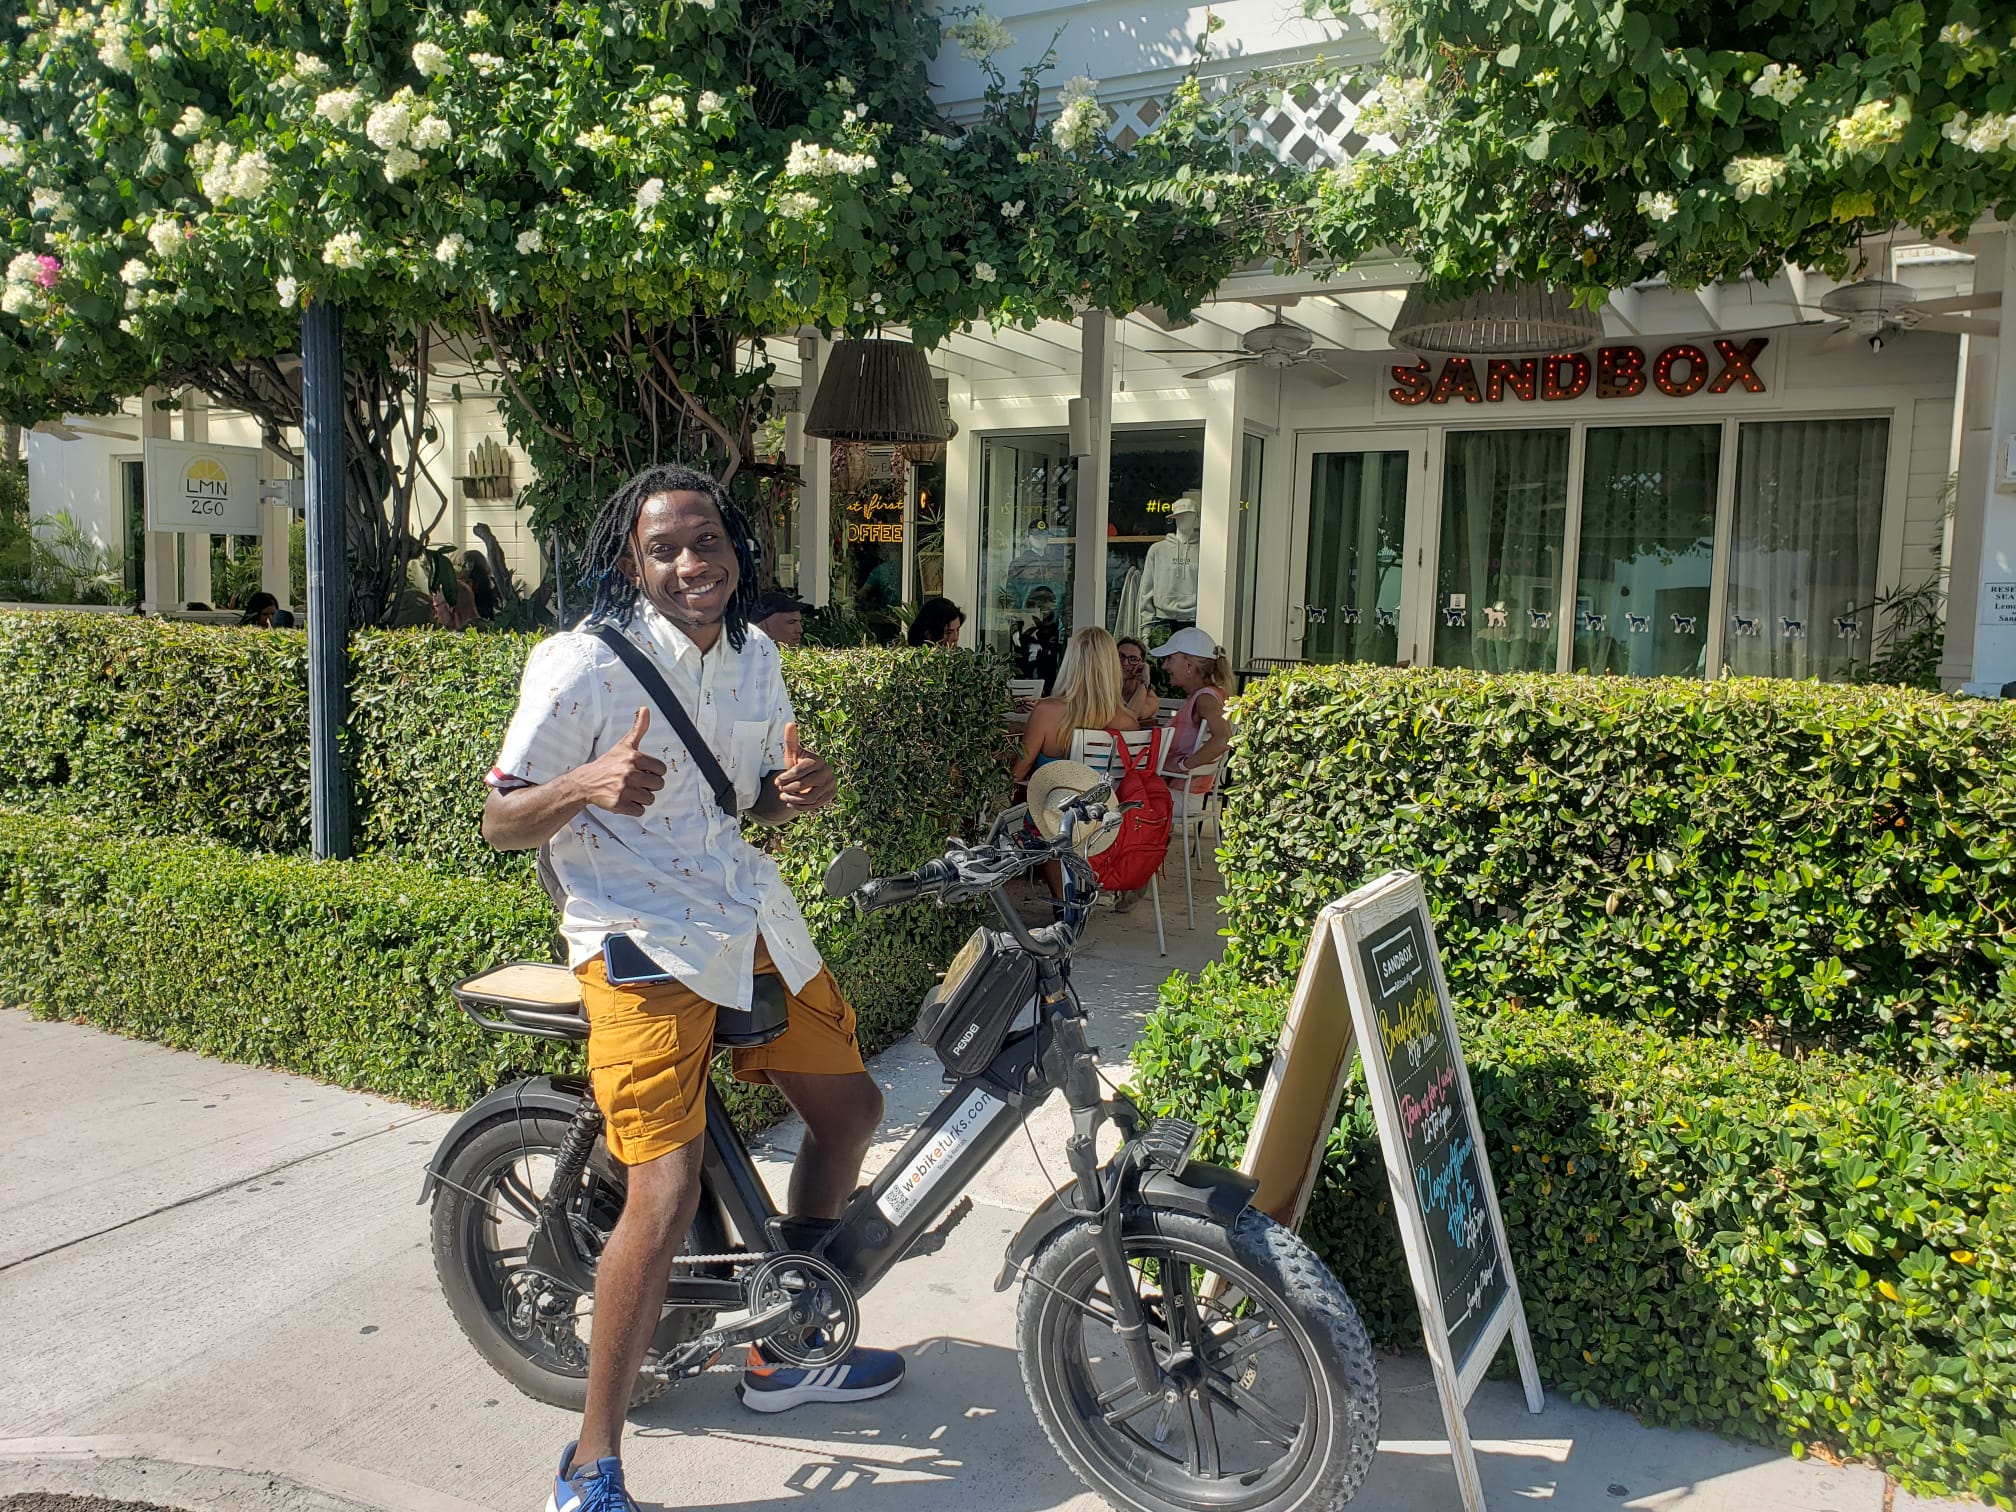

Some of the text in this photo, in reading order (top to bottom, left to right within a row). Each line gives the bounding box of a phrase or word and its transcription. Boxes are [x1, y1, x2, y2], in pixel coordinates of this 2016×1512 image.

[1389, 338, 1769, 405] SANDBOX
[186, 478, 227, 496] LMN
[191, 500, 224, 516] 2GO
[865, 493, 904, 520] first
[848, 523, 903, 543] OFFEE
[1382, 944, 1413, 978] SANDBOX
[1401, 1094, 1422, 1139] Join
